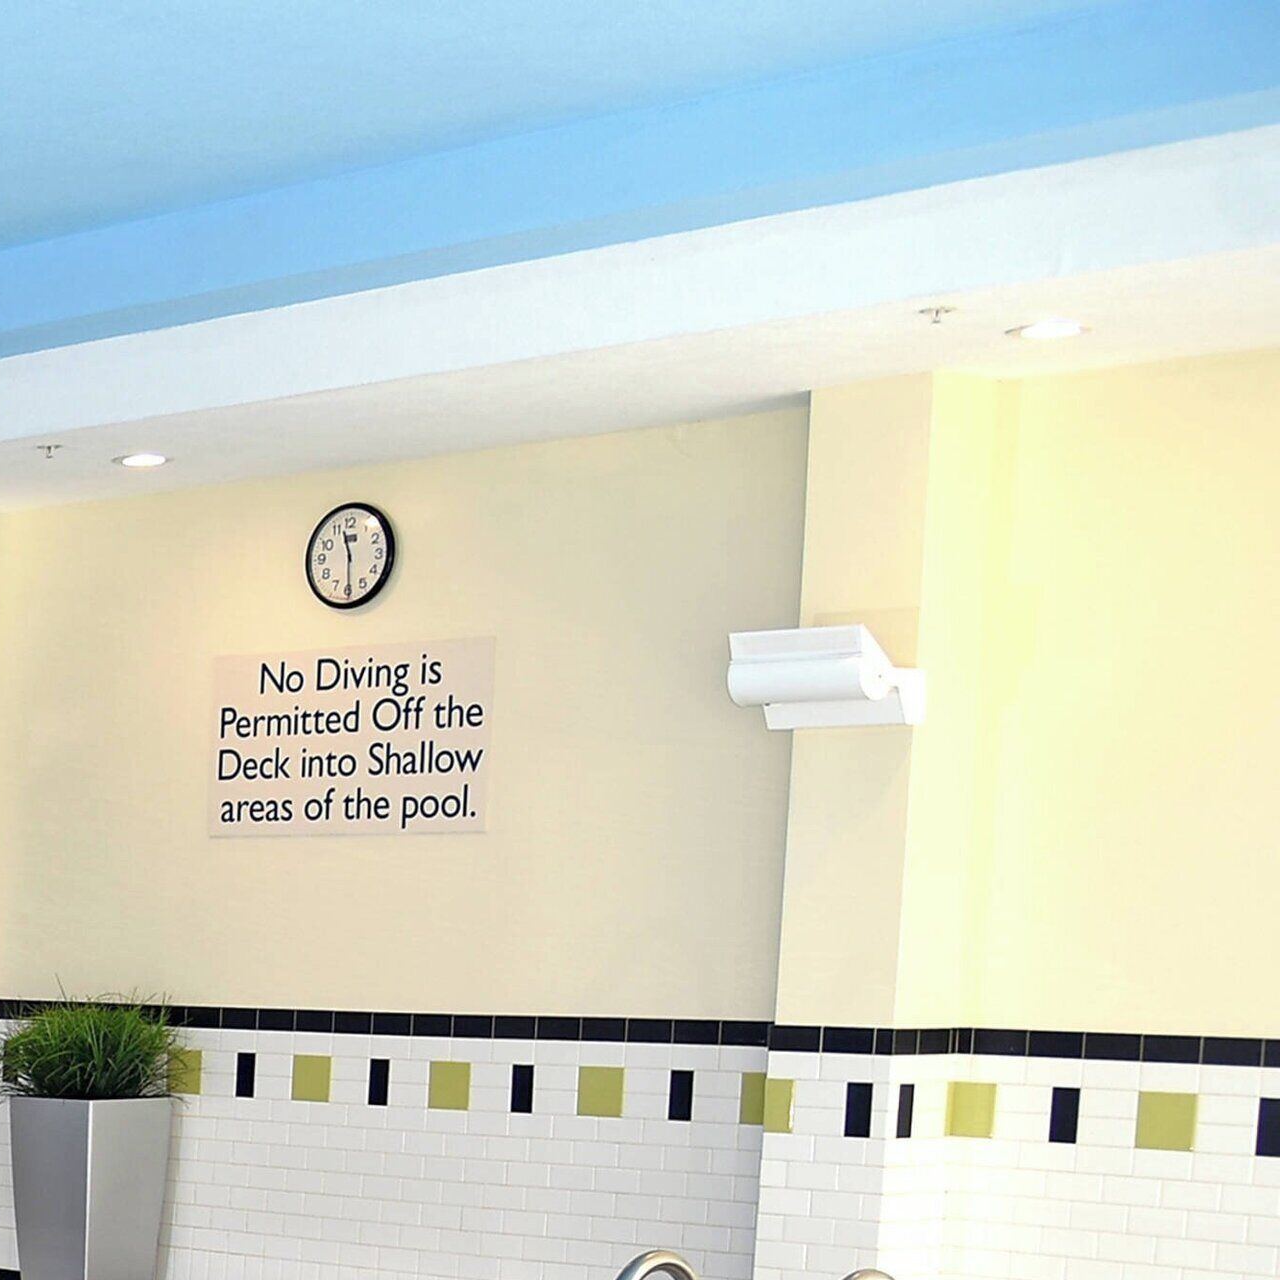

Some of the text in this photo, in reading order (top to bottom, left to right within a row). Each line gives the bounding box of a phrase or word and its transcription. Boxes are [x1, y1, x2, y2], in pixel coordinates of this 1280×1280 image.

[345, 517, 357, 528] 12
[333, 524, 341, 535] 11
[371, 532, 380, 544] 2
[321, 539, 334, 551] 10
[317, 553, 326, 565] 9
[374, 548, 383, 560] 3
[322, 568, 330, 580] 8
[369, 564, 377, 575] 4
[332, 580, 339, 591] 7
[359, 578, 367, 589] 5
[260, 654, 441, 696] No Diving is
[220, 695, 483, 738] Permitted Off the
[218, 740, 483, 780] Deck into Shallow
[221, 784, 476, 829] areas of the pool.
